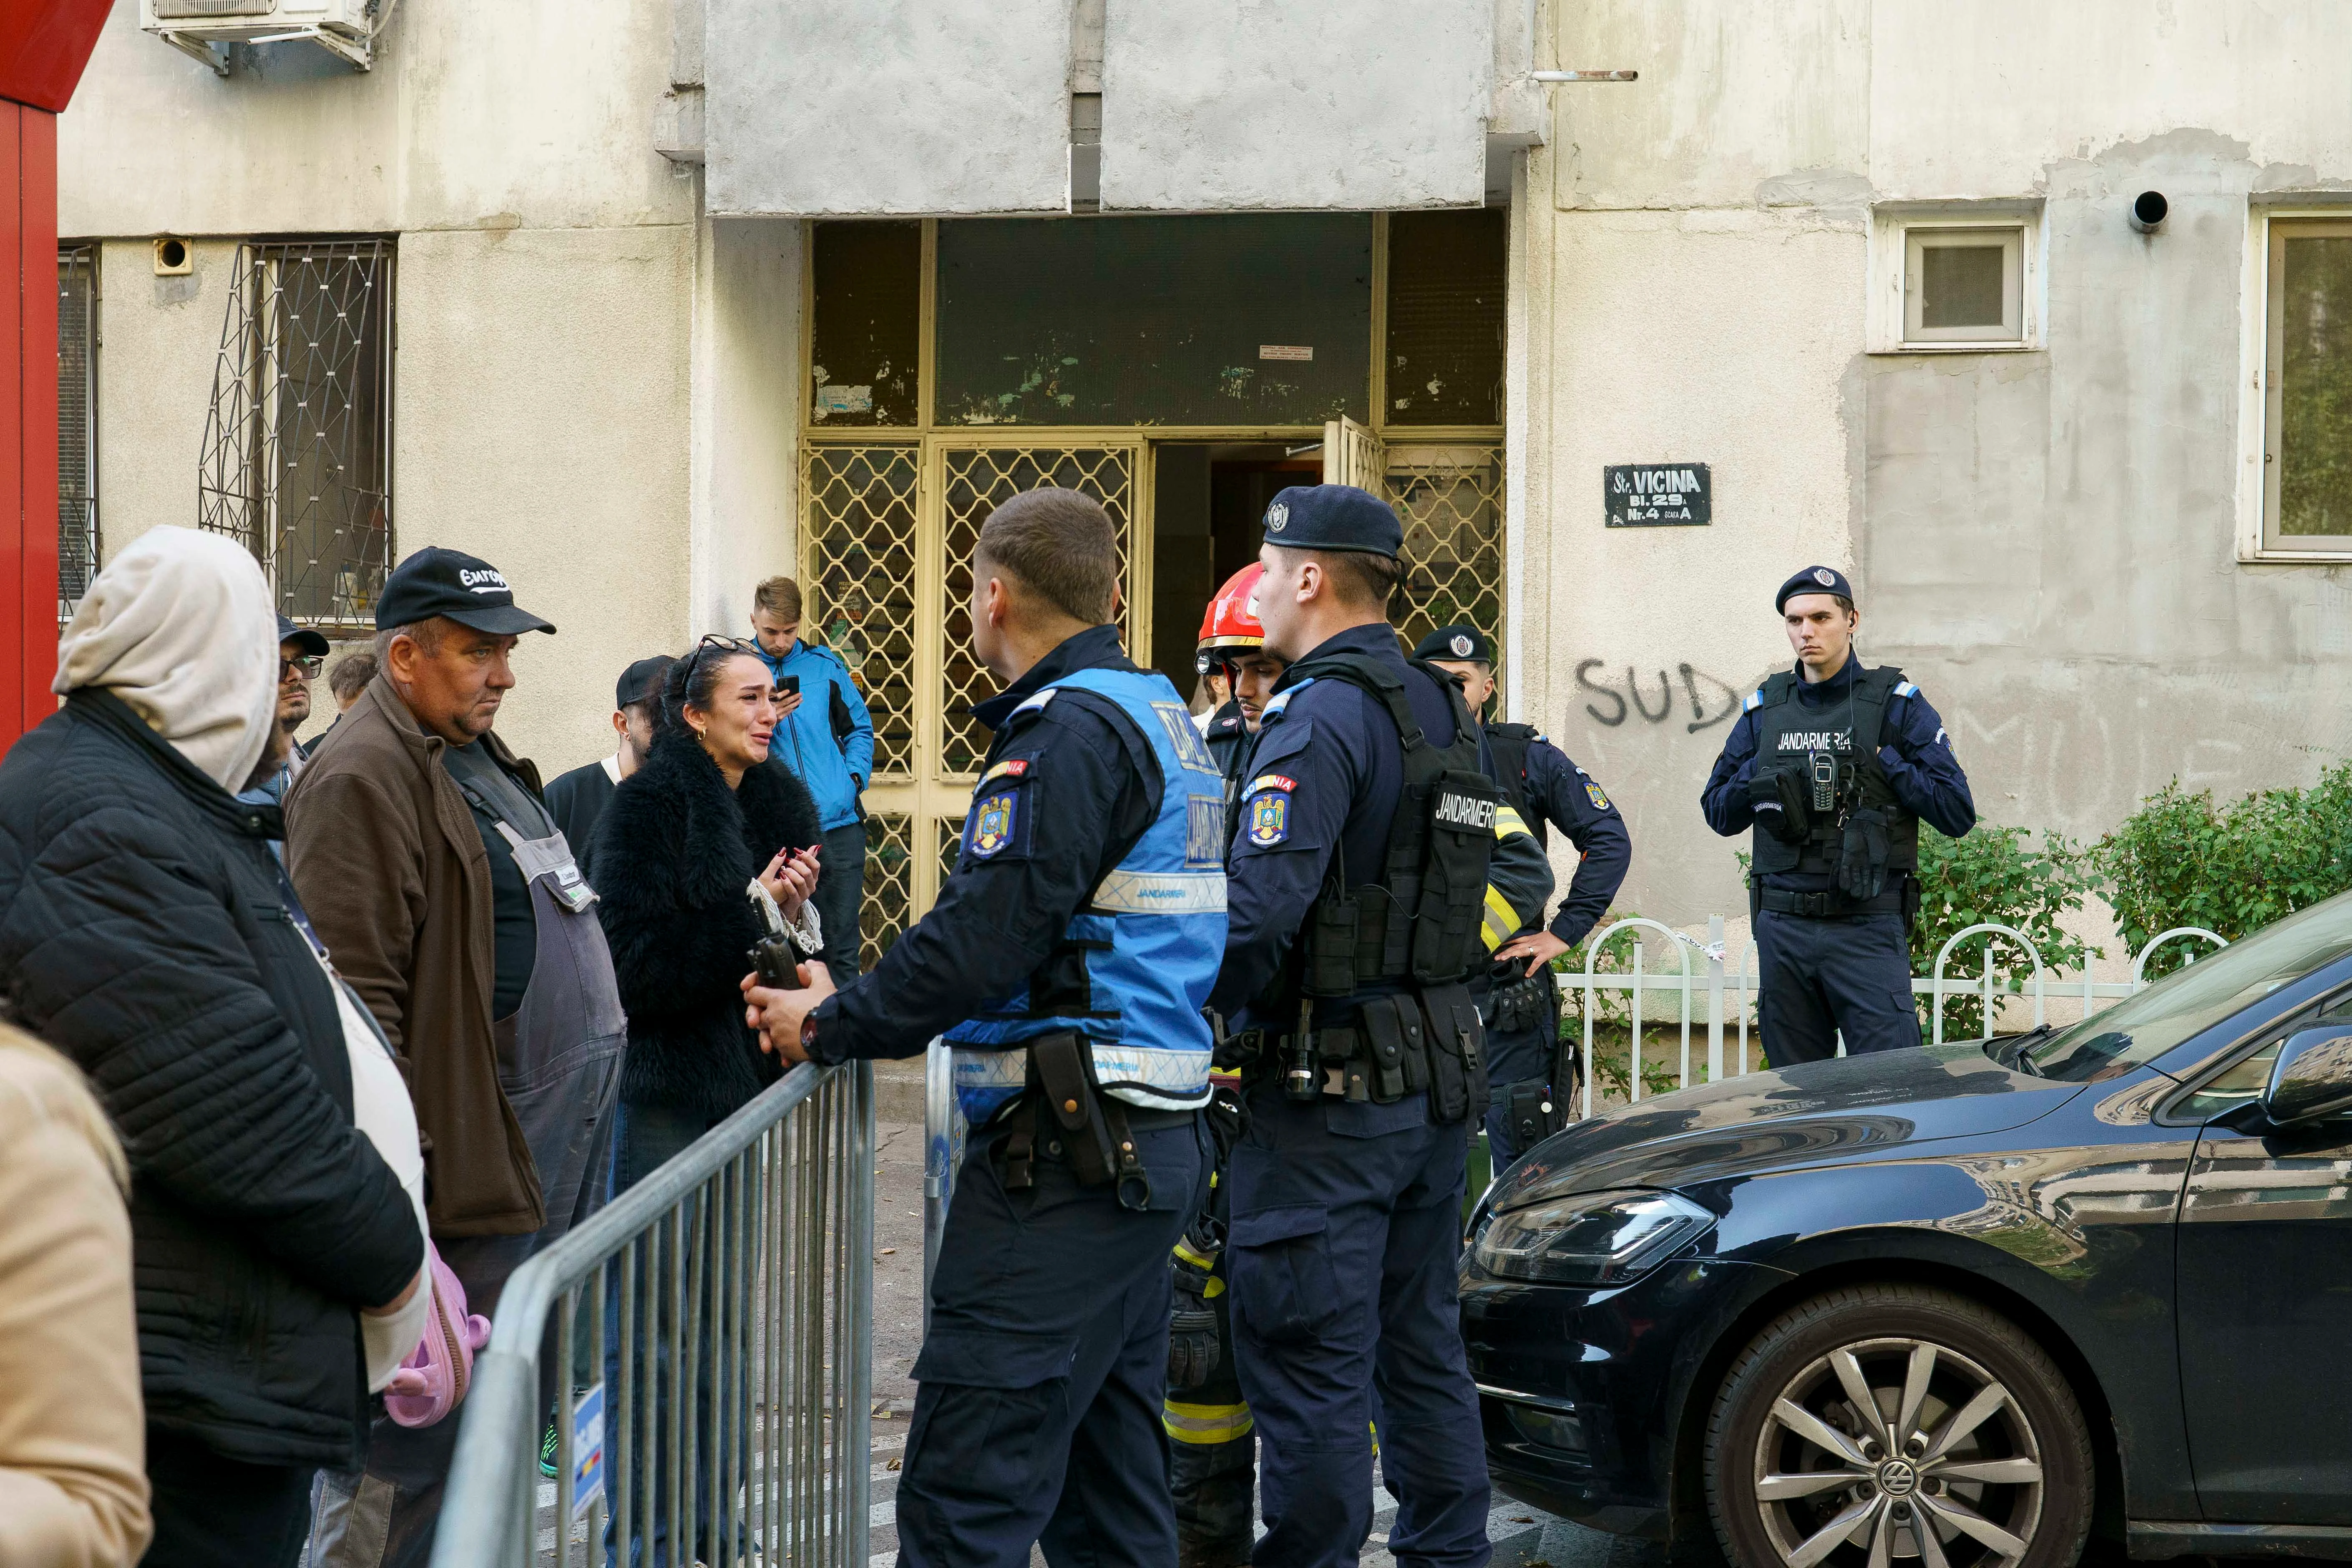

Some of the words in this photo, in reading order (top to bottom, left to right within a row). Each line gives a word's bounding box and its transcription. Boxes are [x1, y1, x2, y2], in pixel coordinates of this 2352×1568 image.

[1613, 471, 1631, 494] Str.
[1633, 470, 1701, 494] VICINA
[1680, 507, 1691, 520] A
[1575, 658, 1739, 734] SUD
[1778, 732, 1851, 750] JANDARMERIA
[1436, 793, 1497, 829] JANDARMERI
[1754, 801, 1782, 812] JANDARMERIA
